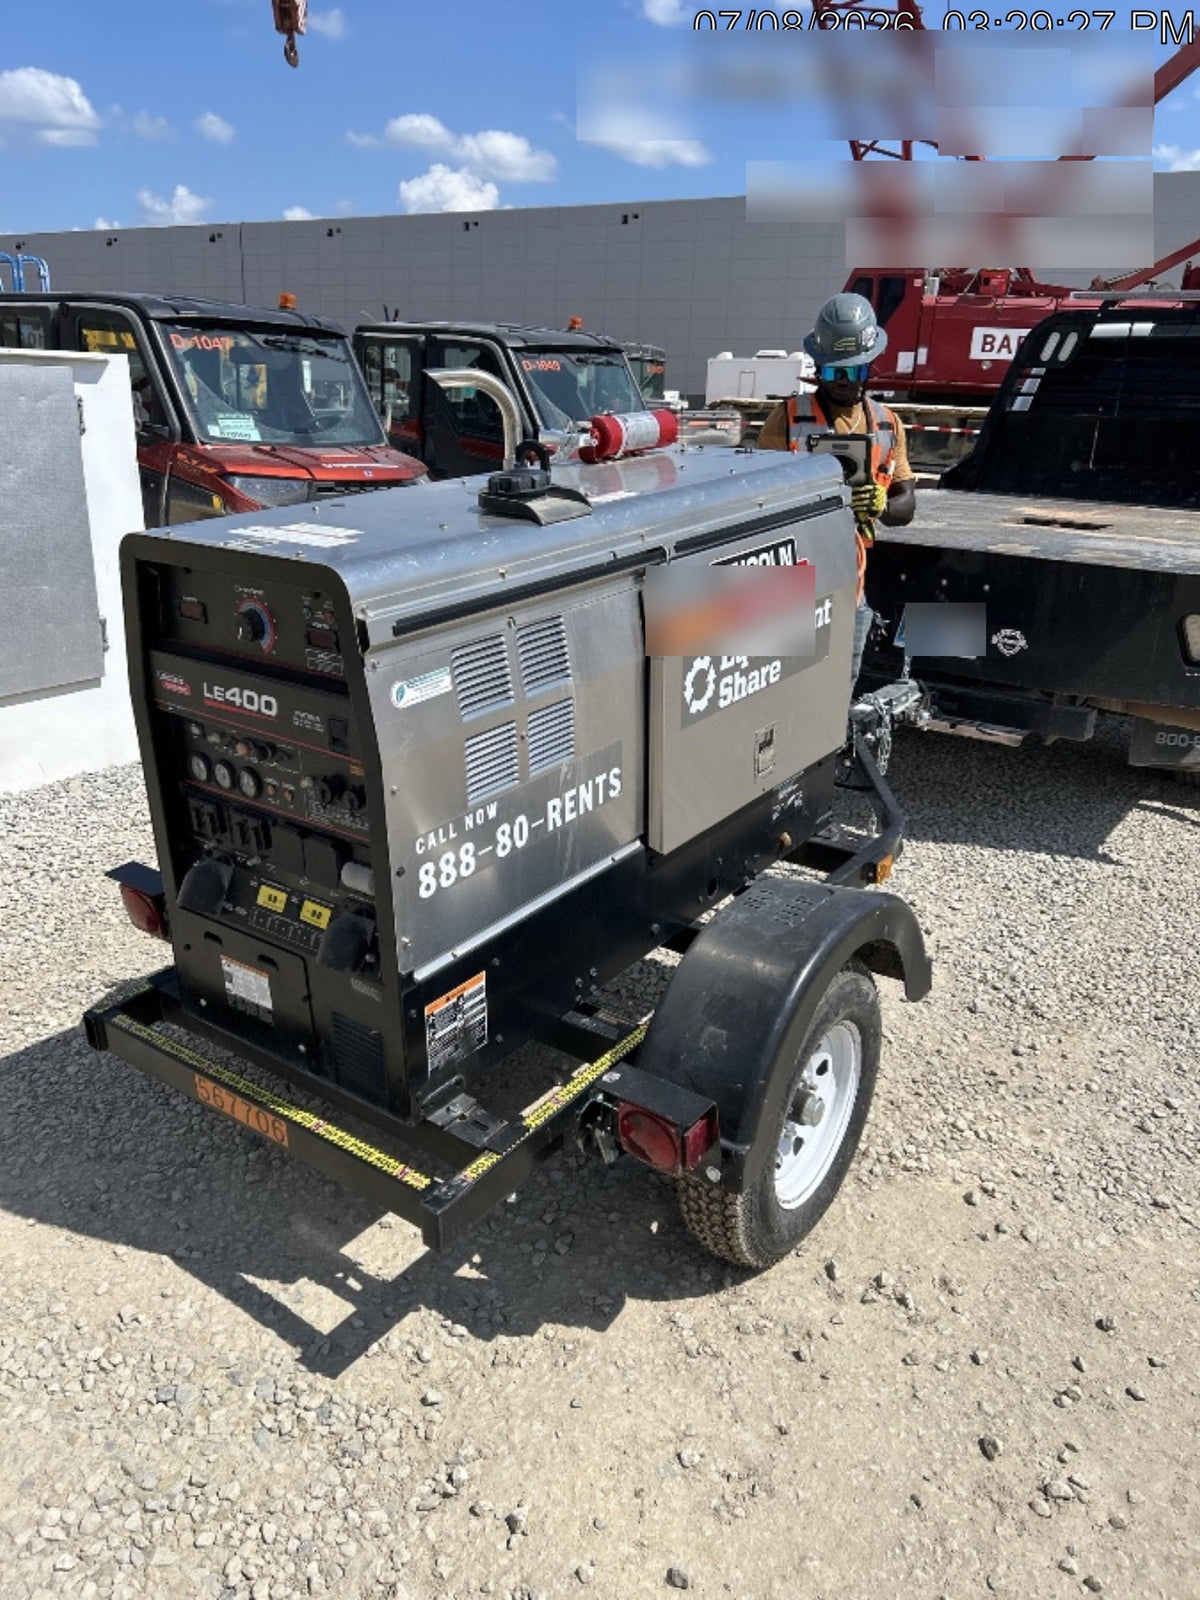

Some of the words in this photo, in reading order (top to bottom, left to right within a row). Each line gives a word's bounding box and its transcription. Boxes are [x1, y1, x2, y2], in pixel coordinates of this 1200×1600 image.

[203, 682, 278, 717] LE400
[719, 659, 781, 708] Share
[415, 823, 457, 854] CALL
[464, 801, 498, 831] NOW
[418, 767, 622, 899] 888-80-RENTS
[197, 1077, 285, 1143] 567706
